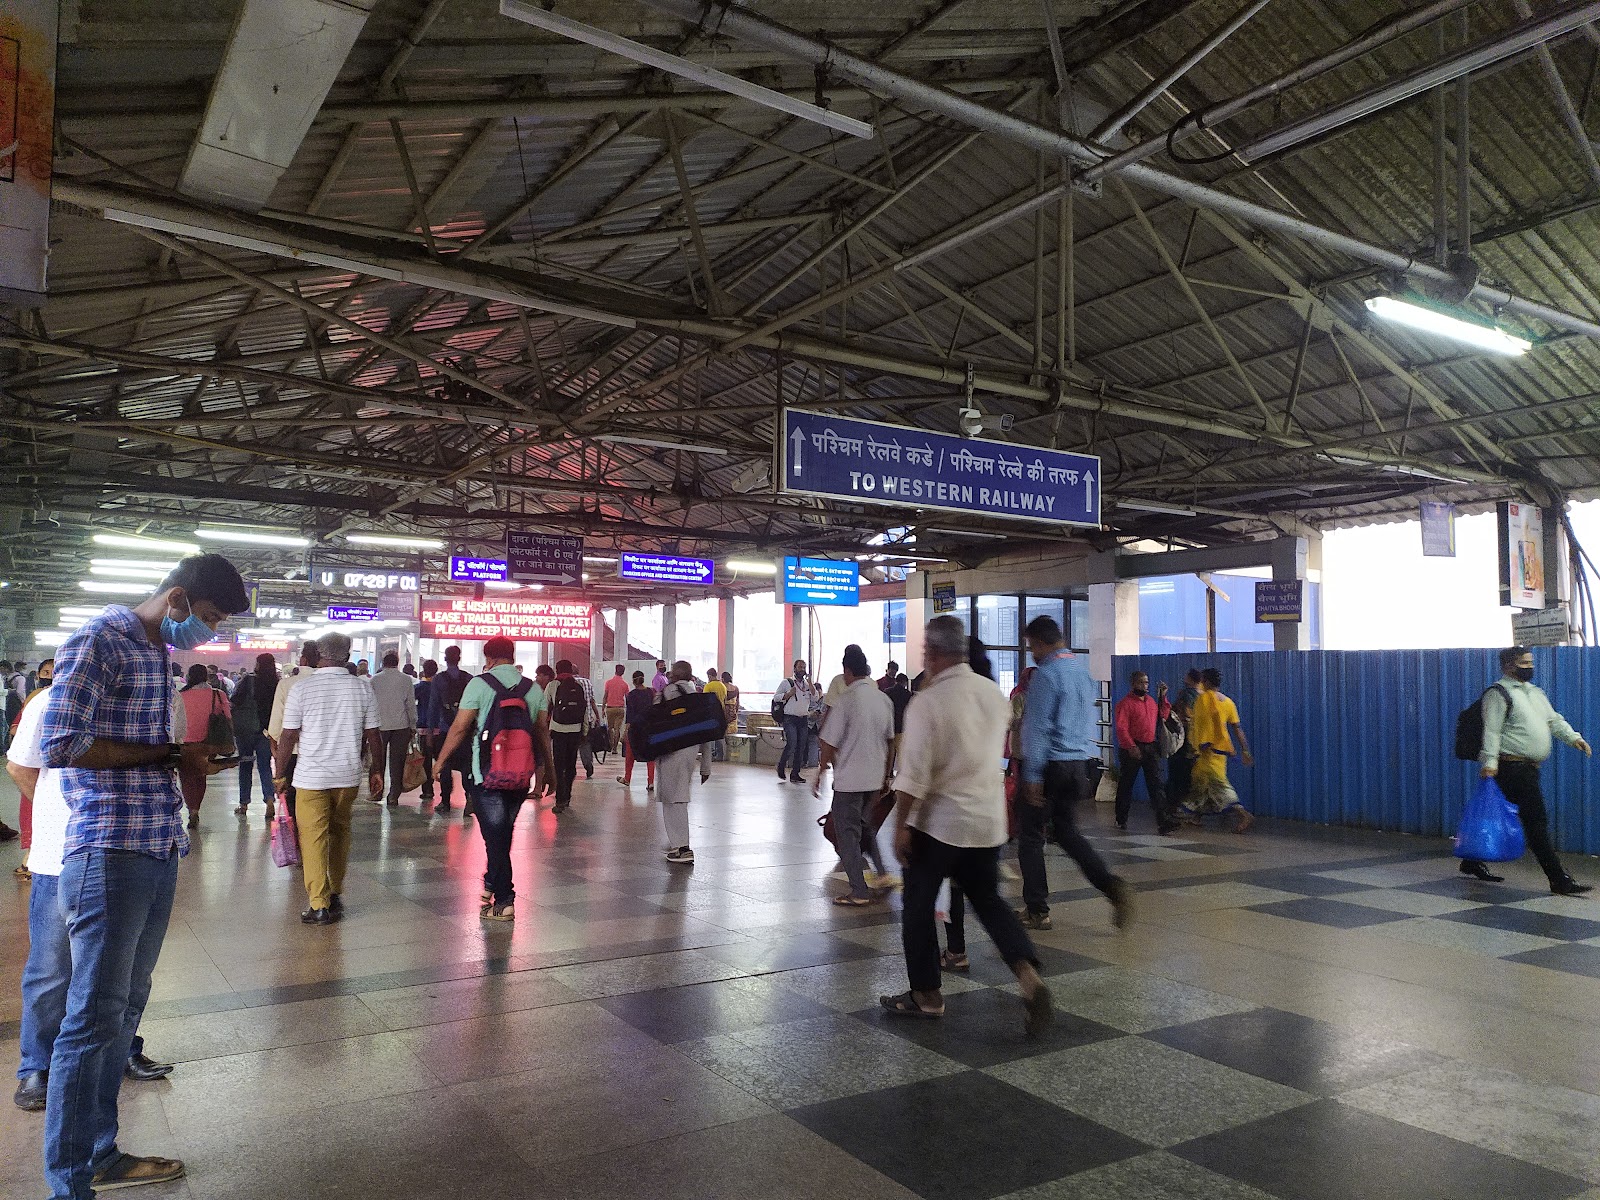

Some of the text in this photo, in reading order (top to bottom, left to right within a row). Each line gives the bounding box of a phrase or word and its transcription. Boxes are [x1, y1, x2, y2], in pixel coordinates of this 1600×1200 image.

[811, 428, 1079, 486] पश्चिम रेलवे कडे / पश्चिम रेल्वे की तरफ
[849, 471, 1056, 513] TO WESTERN RAILWAY
[511, 534, 581, 549] दादर (पश्चिम रेल्वे)
[509, 546, 541, 557] प्लेटफॉर्म
[554, 549, 560, 558] 6
[562, 550, 574, 561] एवं
[576, 551, 582, 560] 7
[457, 560, 465, 572] 5
[516, 560, 528, 569] पर
[529, 559, 543, 569] जाने
[544, 562, 555, 570] का
[557, 562, 577, 572] रास्ता
[344, 573, 387, 588] 07:28
[387, 575, 399, 589] F
[400, 575, 418, 590] 01
[473, 571, 502, 580] PLATFORM
[452, 600, 590, 616] WE WISH YOU A HAPPY JOURNEY
[1257, 604, 1279, 612] CHAITYA
[422, 611, 461, 623] PLEASE
[558, 617, 590, 628] TICKET
[435, 623, 590, 639] PLEASE KEEP THE STATION CLEAN
